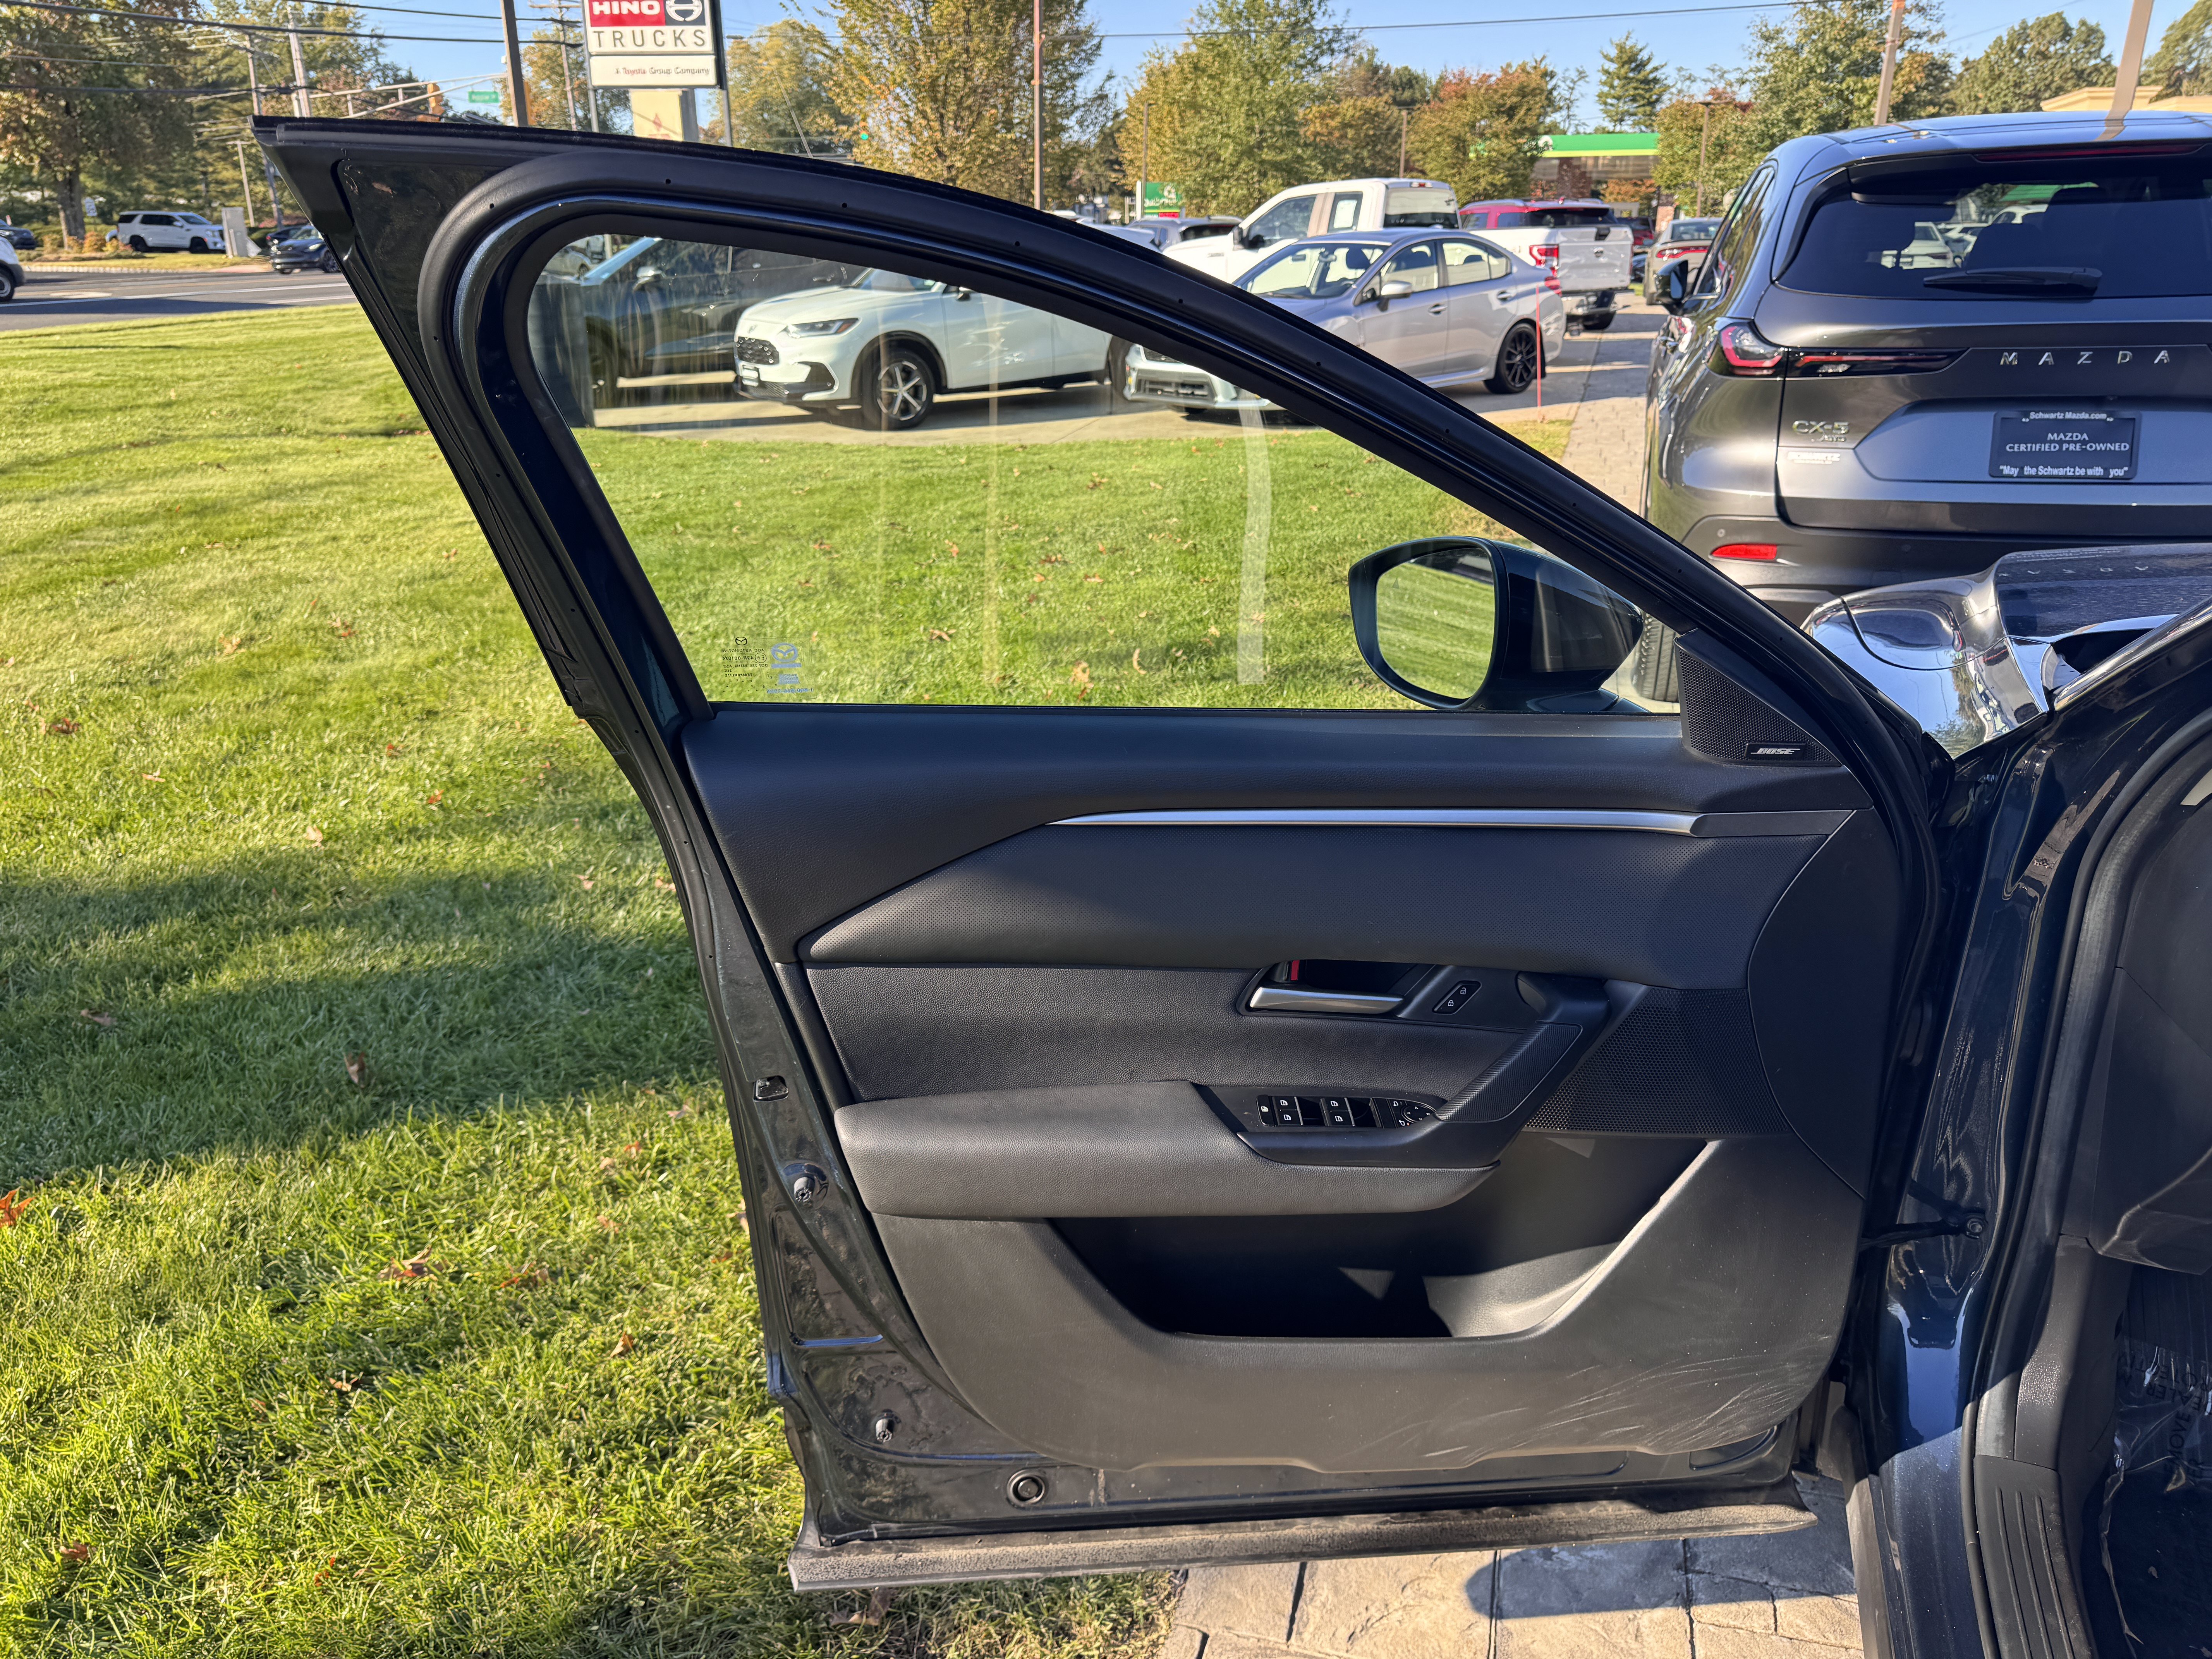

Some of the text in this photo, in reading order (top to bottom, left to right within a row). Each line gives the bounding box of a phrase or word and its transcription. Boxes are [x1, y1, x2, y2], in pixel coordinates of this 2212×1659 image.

[592, 1, 660, 15] HINO
[592, 29, 705, 48] TRUCKS
[674, 67, 710, 75] Company
[2000, 350, 2170, 365] MAZDA
[1792, 420, 1849, 434] CX-5
[2006, 443, 2130, 452] CERTIFIED PRE-OWNED
[2024, 465, 2037, 475] the
[2037, 465, 2074, 475] Schwartz
[2075, 466, 2086, 475] be
[2087, 466, 2104, 476] with
